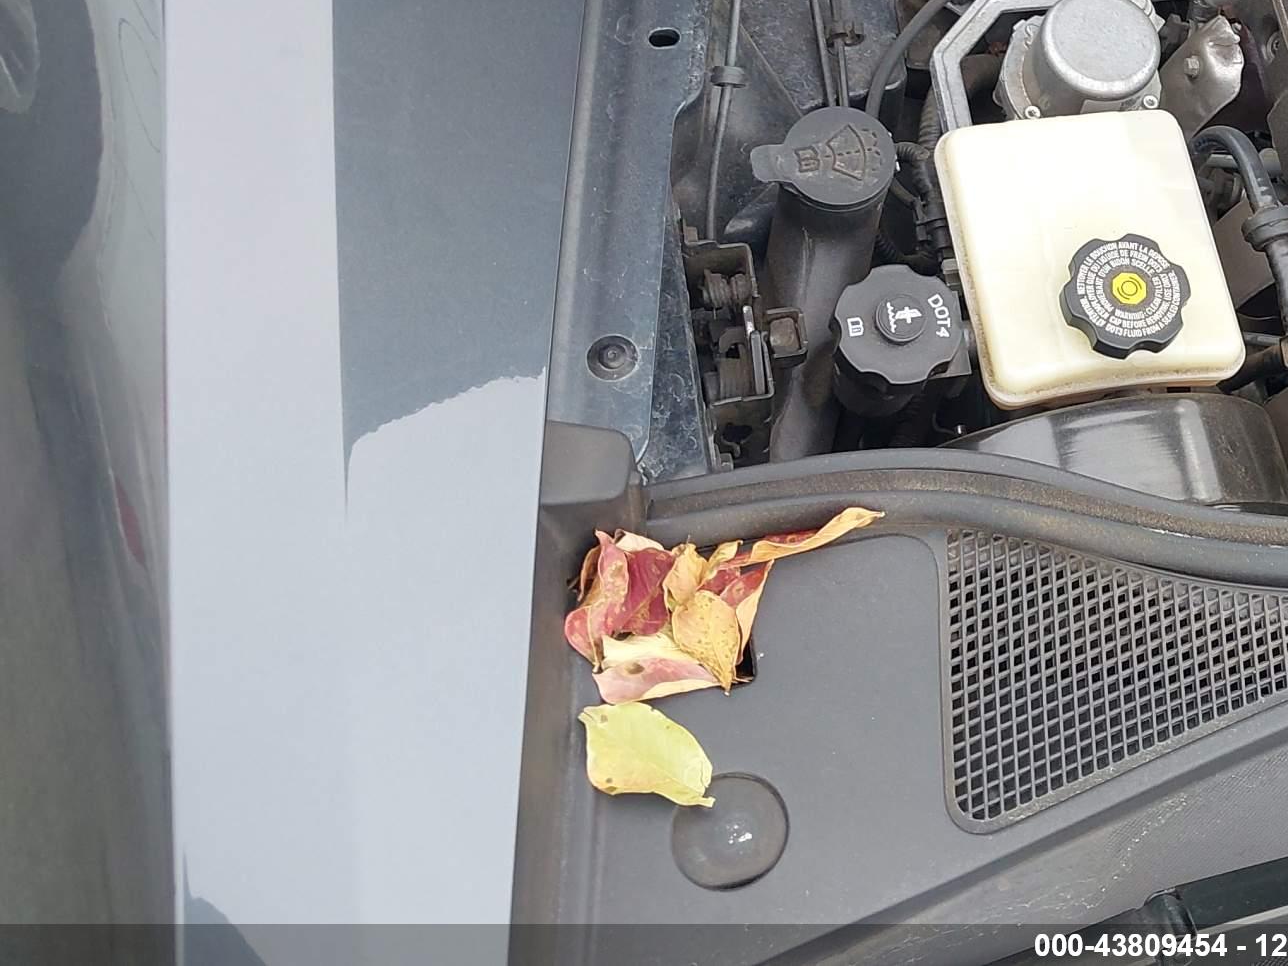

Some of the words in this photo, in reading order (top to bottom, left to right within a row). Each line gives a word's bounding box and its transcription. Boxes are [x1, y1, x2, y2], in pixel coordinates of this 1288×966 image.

[1083, 256, 1094, 266] LE
[1118, 242, 1139, 250] AVANT
[1139, 244, 1148, 254] LA
[1109, 316, 1121, 325] CAP
[1122, 320, 1147, 328] BEFORE
[1164, 288, 1172, 300] USE
[1105, 323, 1123, 336] DOT3
[1123, 329, 1142, 337] FLUID
[1142, 324, 1161, 336] FROM
[1158, 321, 1165, 329] A
